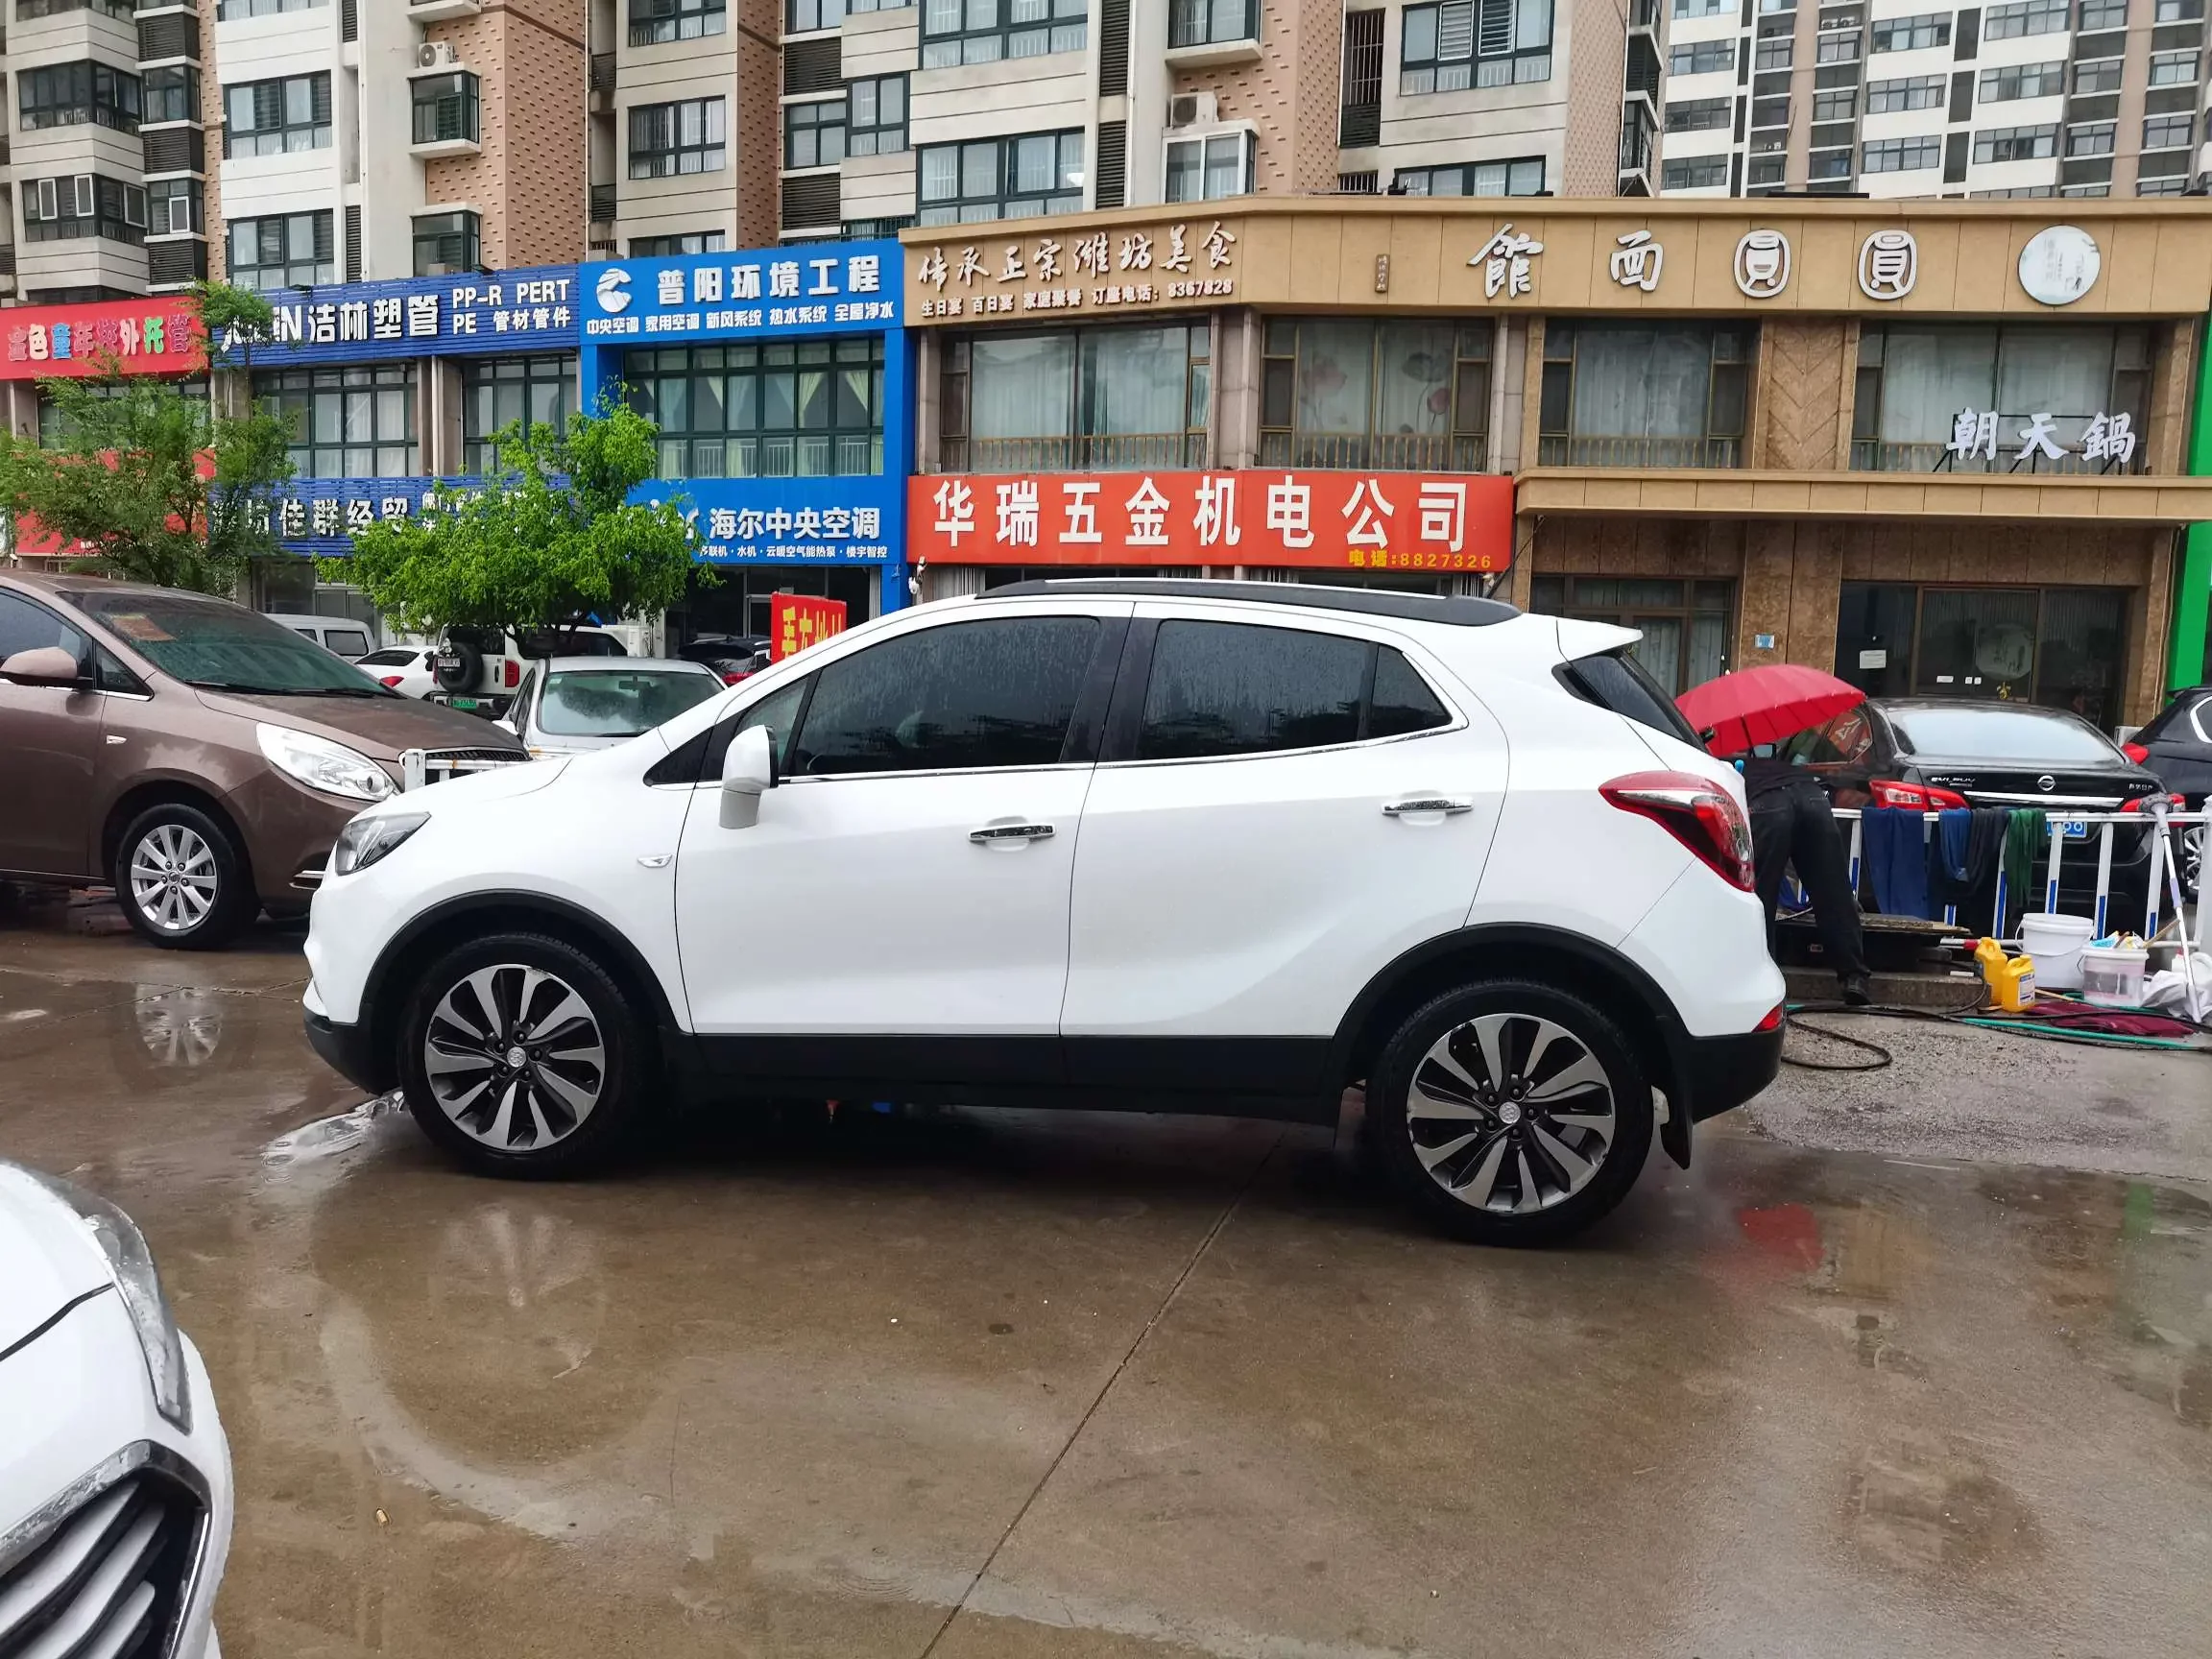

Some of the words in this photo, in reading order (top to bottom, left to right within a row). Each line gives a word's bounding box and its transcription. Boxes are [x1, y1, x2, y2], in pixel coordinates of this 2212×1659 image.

[918, 221, 1237, 292] 传承正宗潍坊美食
[452, 284, 502, 308] PP-R
[517, 279, 570, 304] PERT
[658, 254, 880, 305] 普阳环境工程
[307, 294, 440, 343] 洁林塑管
[453, 312, 477, 335] PE
[493, 305, 571, 333] 管材管件
[587, 316, 639, 335] 中央空调
[645, 312, 700, 332] 家用空调
[707, 309, 762, 329] 新风系统
[769, 305, 828, 325] 热水系统
[834, 301, 894, 322] 全屋净水
[921, 297, 963, 318] 生日宴
[972, 293, 1015, 314] 百日宴
[709, 507, 880, 540] 海尔中央空调
[933, 475, 1467, 552] 华瑞五金机电公司
